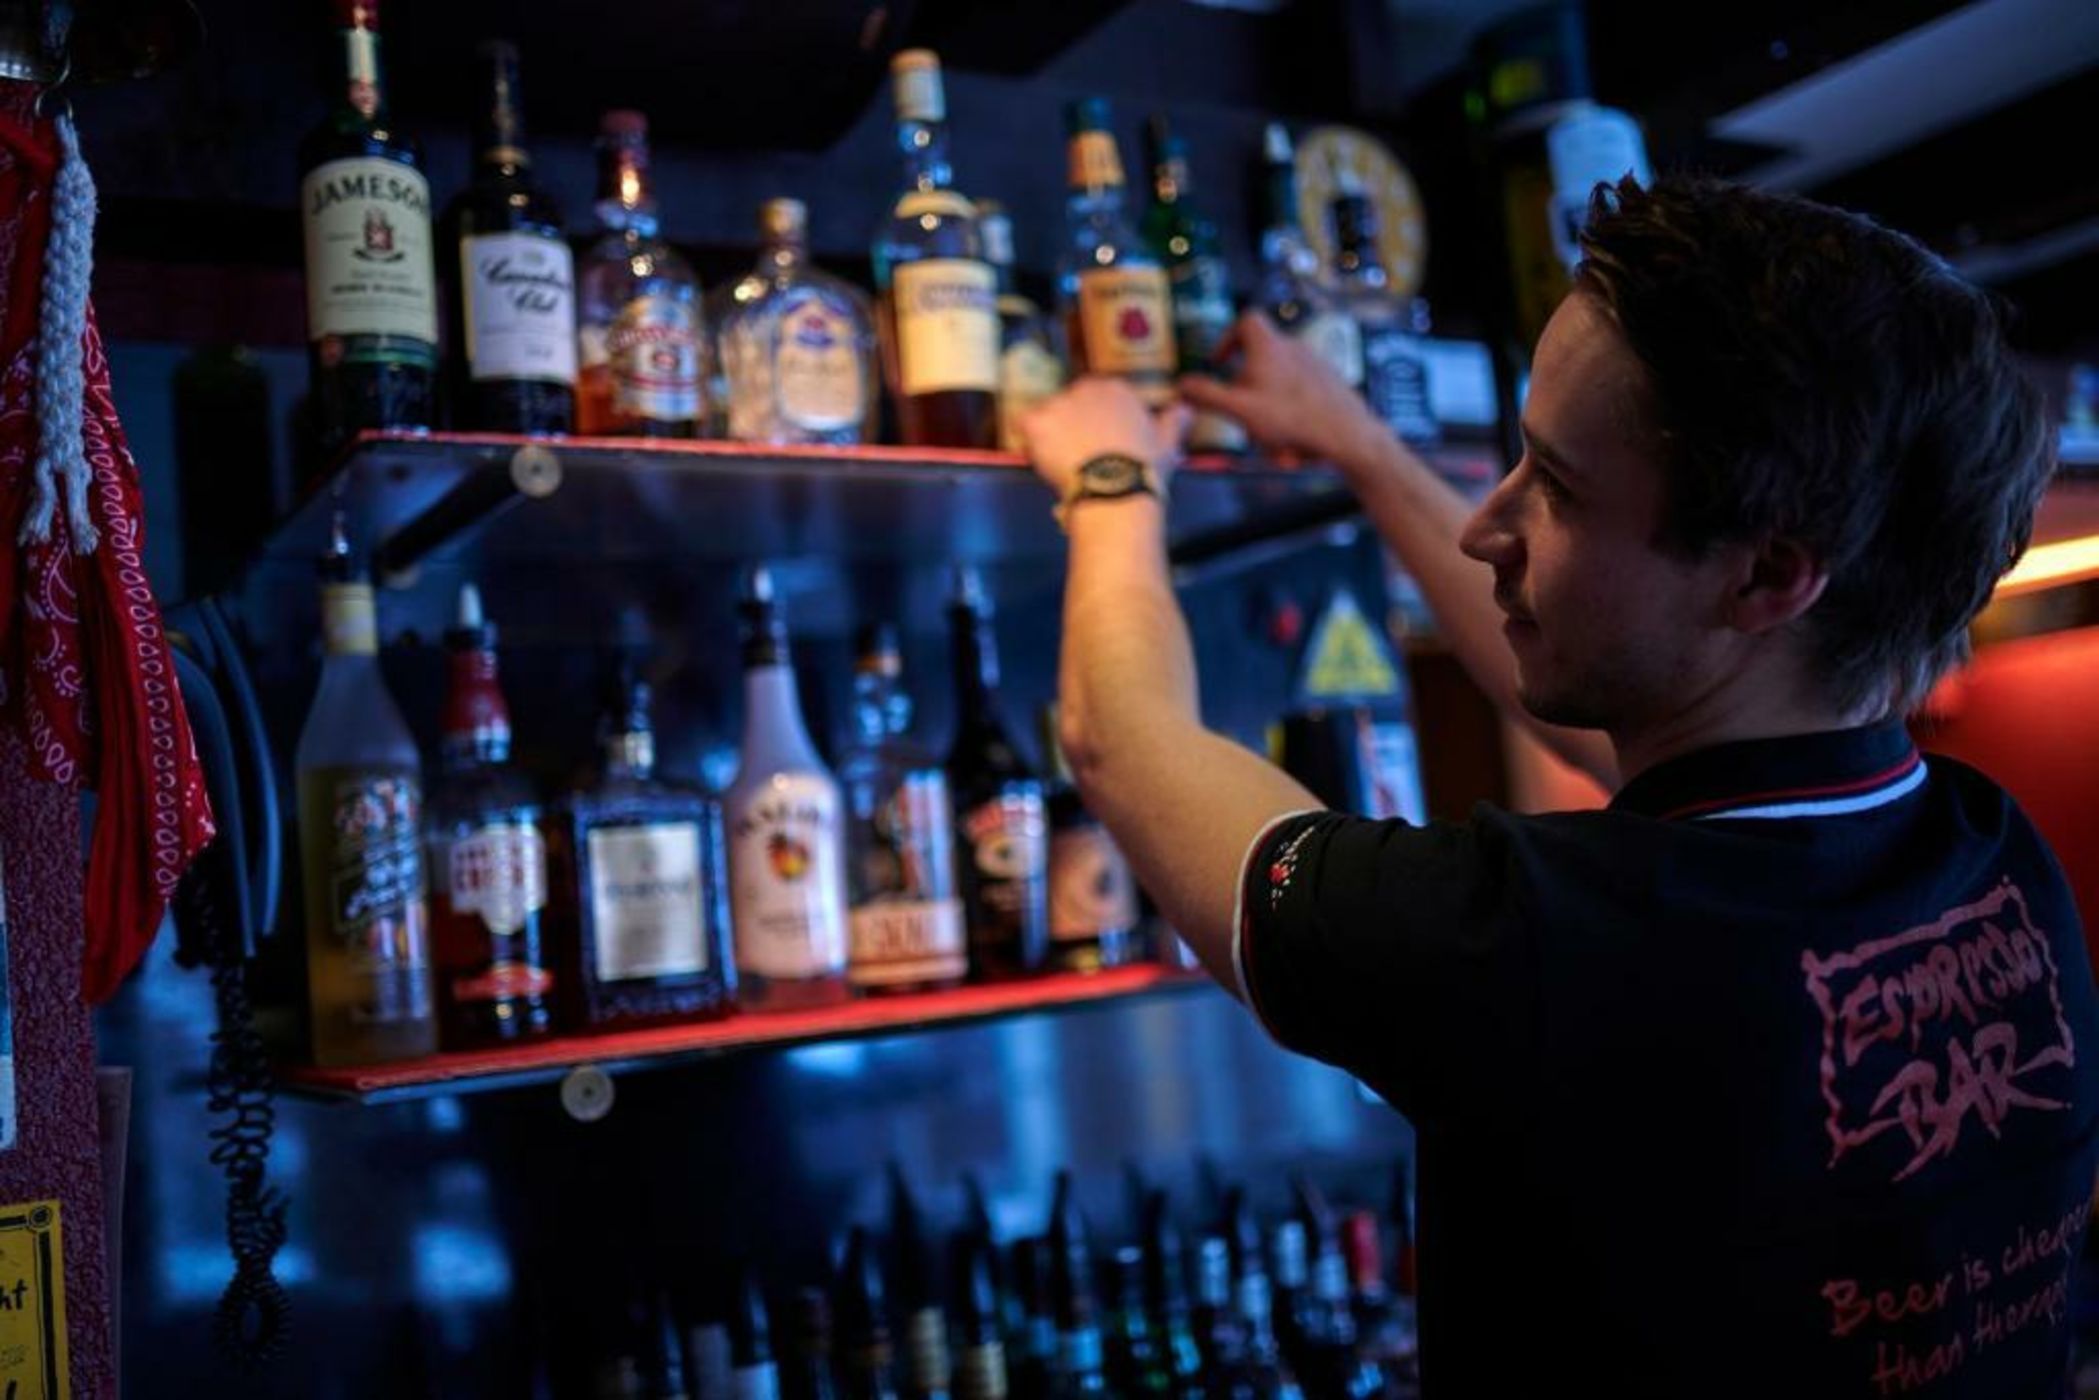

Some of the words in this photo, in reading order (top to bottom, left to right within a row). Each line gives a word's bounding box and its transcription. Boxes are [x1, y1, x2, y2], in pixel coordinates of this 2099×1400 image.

[1869, 1022, 2073, 1183] BAR
[1820, 1272, 1952, 1338] Beer
[1962, 1251, 1993, 1295] is
[1870, 1331, 1968, 1394] than
